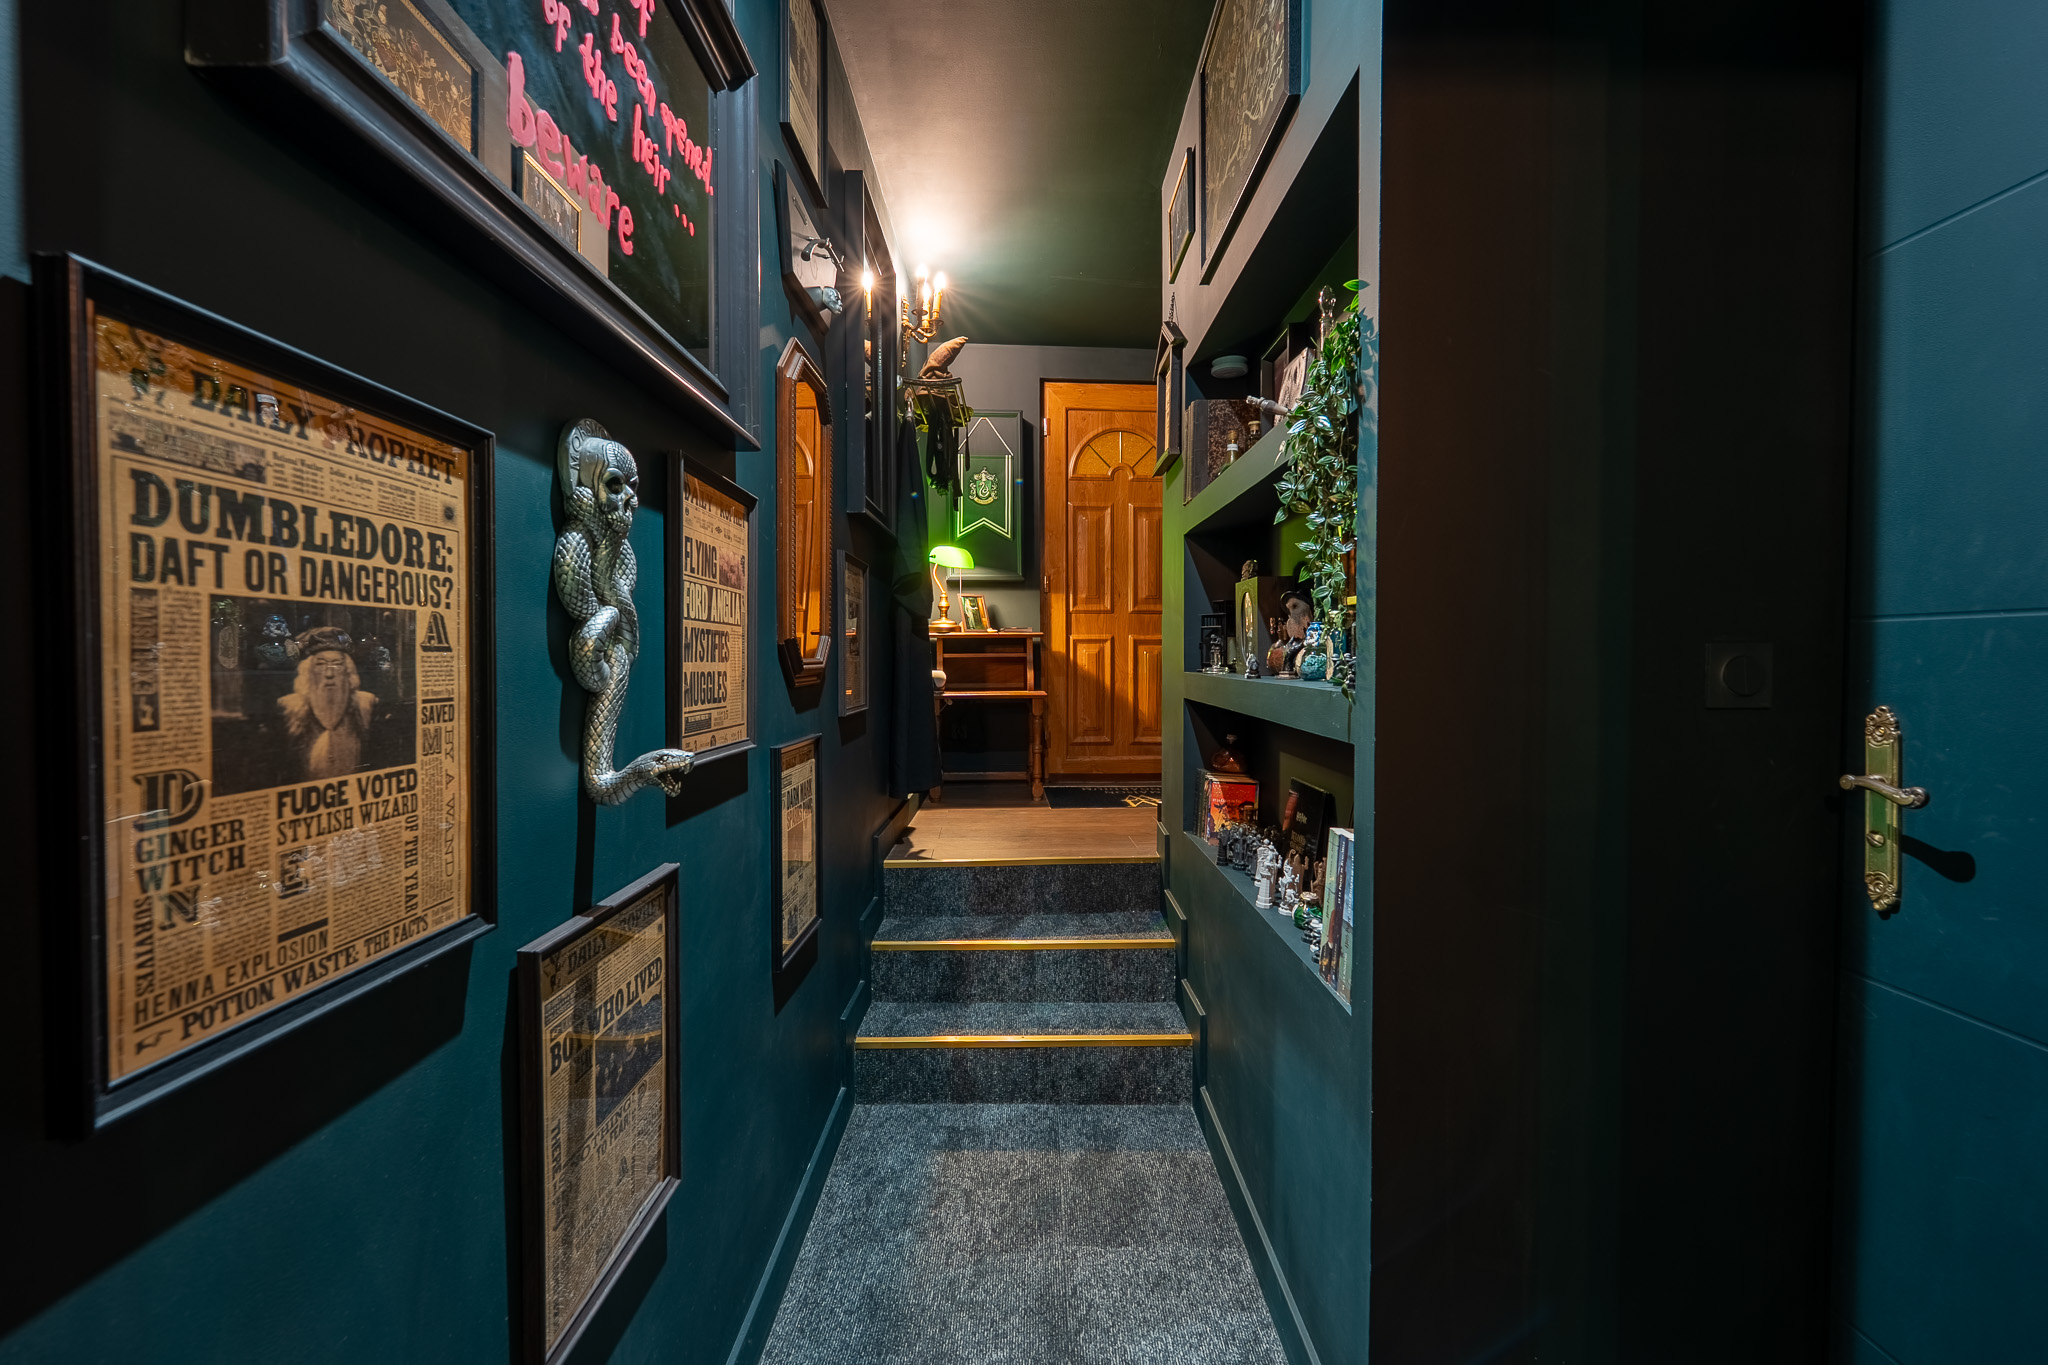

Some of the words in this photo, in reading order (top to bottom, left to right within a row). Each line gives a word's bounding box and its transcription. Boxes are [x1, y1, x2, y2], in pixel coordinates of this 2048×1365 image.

[610, 12, 656, 117] been
[542, 0, 571, 53] of
[579, 33, 618, 122] the
[632, 104, 671, 195] heir
[506, 51, 634, 256] beware
[191, 370, 316, 440] DAILY
[318, 408, 457, 485] ROPHET
[129, 467, 454, 574] DUMBLEDORE:
[684, 478, 714, 513] DAILY
[129, 532, 230, 589] DAFT
[245, 549, 289, 596] OR
[301, 555, 455, 610] DANGEROUS?
[684, 535, 718, 580] FLYING
[684, 580, 709, 621] FORD
[711, 587, 742, 626] ANGLIA
[684, 626, 730, 663] MYSTIFIES
[421, 704, 455, 725] SAVED
[684, 670, 728, 708] MUGGLES
[444, 726, 455, 763] BY
[276, 779, 350, 820] FUDGE
[356, 767, 419, 802] VOTED
[444, 769, 455, 790] A
[135, 818, 246, 864] GINGER
[276, 803, 354, 847] STYLISH
[359, 792, 419, 826] WIZARD
[404, 814, 419, 832] OF
[444, 793, 456, 877] WAND
[135, 845, 247, 895] WITCH
[404, 836, 419, 869] THE
[404, 871, 419, 914] YEAR
[134, 898, 156, 998] SURVIVES
[134, 974, 216, 1026] HENNA
[225, 929, 329, 987] EXPLOSION
[181, 980, 275, 1040] POTION
[364, 931, 391, 958] THE
[393, 913, 430, 945] FACTS
[626, 956, 663, 1012] LIVED
